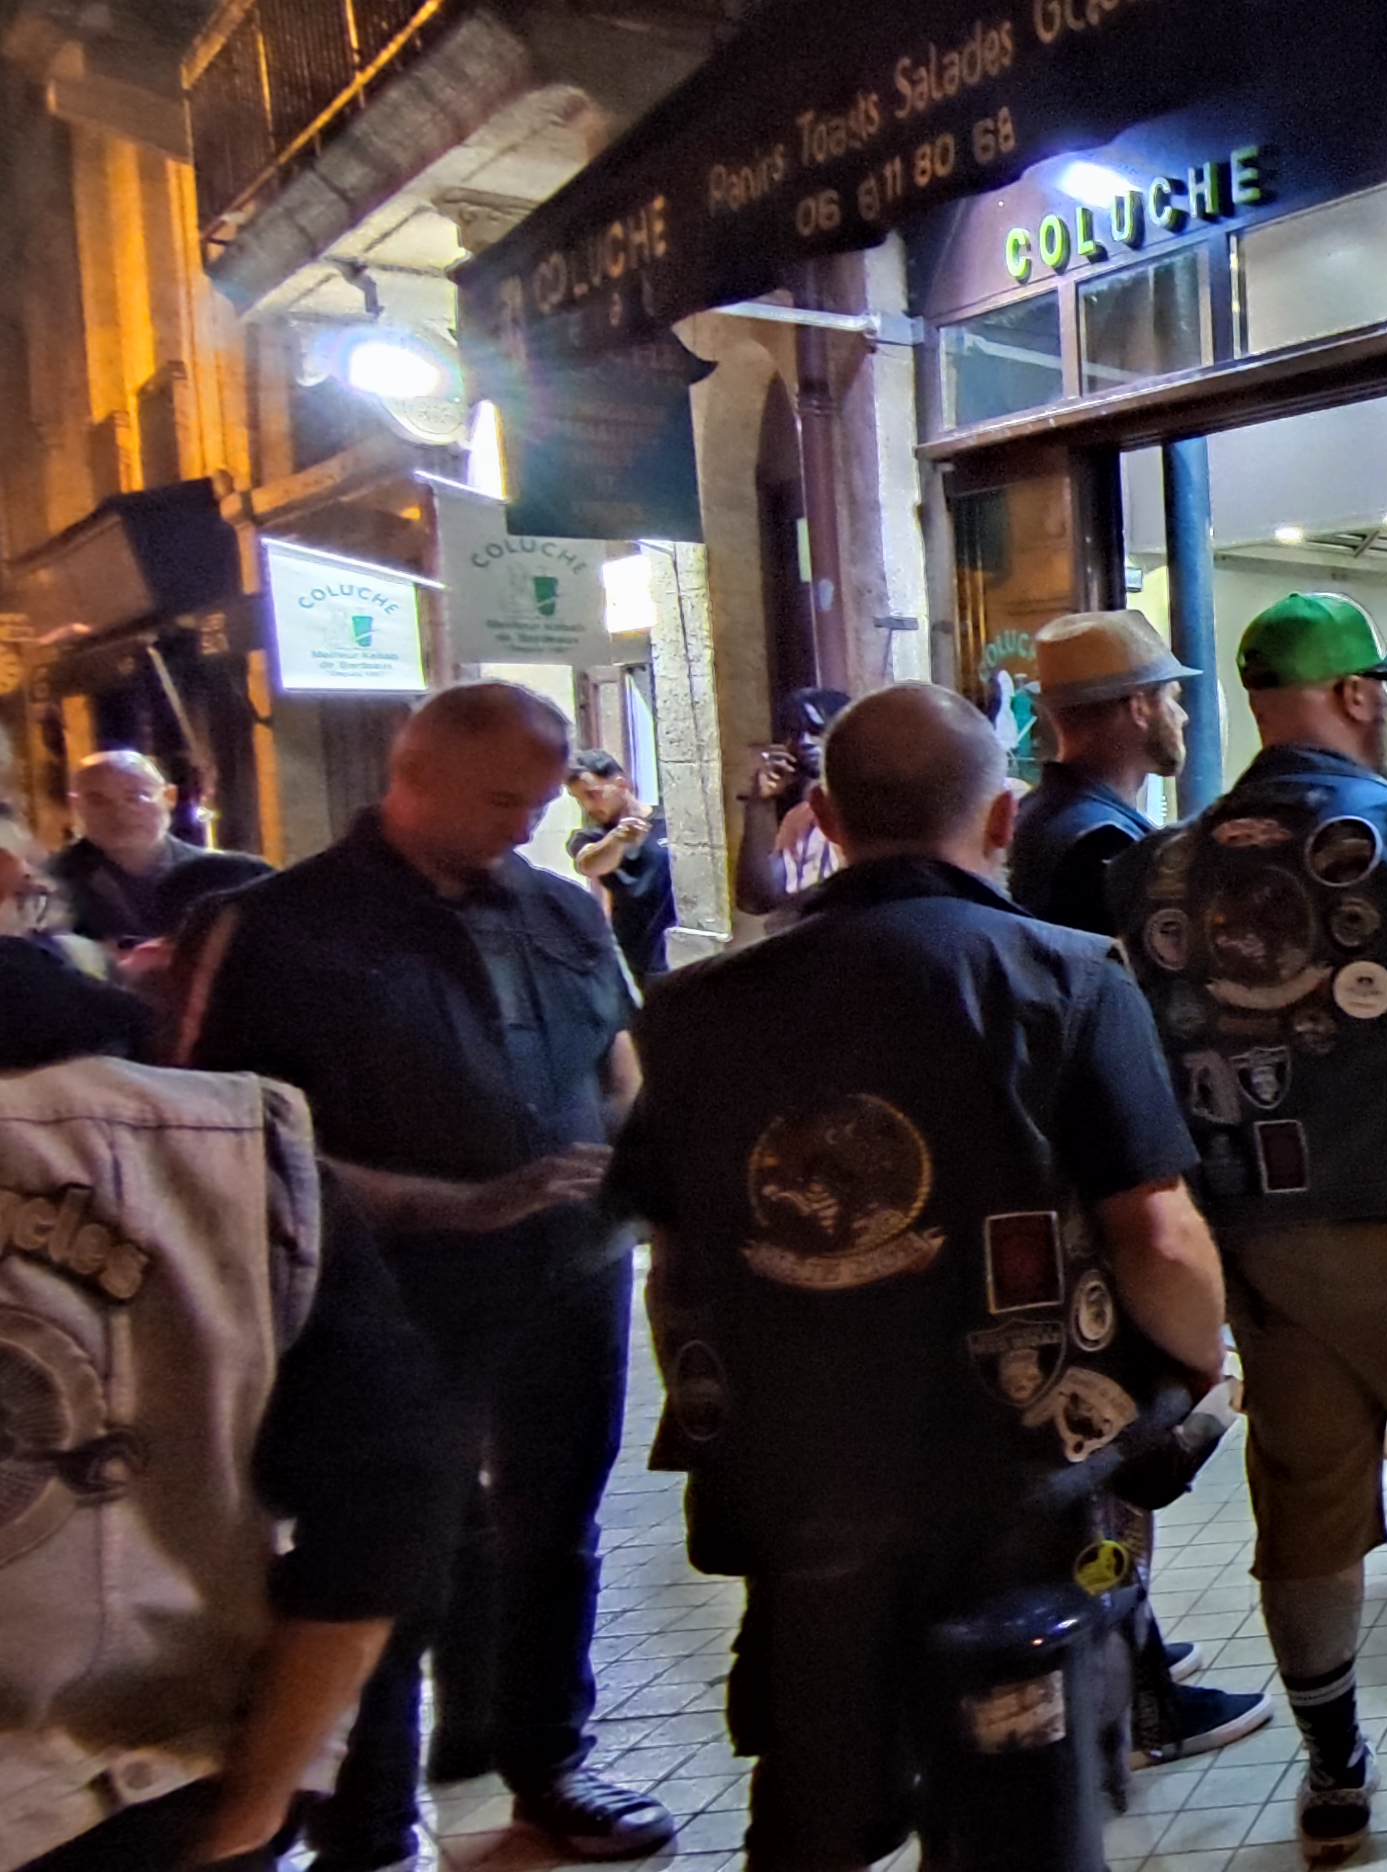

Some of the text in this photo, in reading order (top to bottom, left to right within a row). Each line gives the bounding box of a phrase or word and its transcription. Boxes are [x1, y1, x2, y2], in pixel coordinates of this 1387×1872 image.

[895, 16, 1015, 119] Salades
[795, 189, 842, 237] 06
[913, 133, 955, 188] 80
[972, 105, 1016, 165] 68
[1005, 145, 1262, 280] COLUCHE
[532, 194, 668, 313] COLUCHE
[297, 584, 400, 615] COLUCHE
[471, 537, 589, 576] COLUCHE
